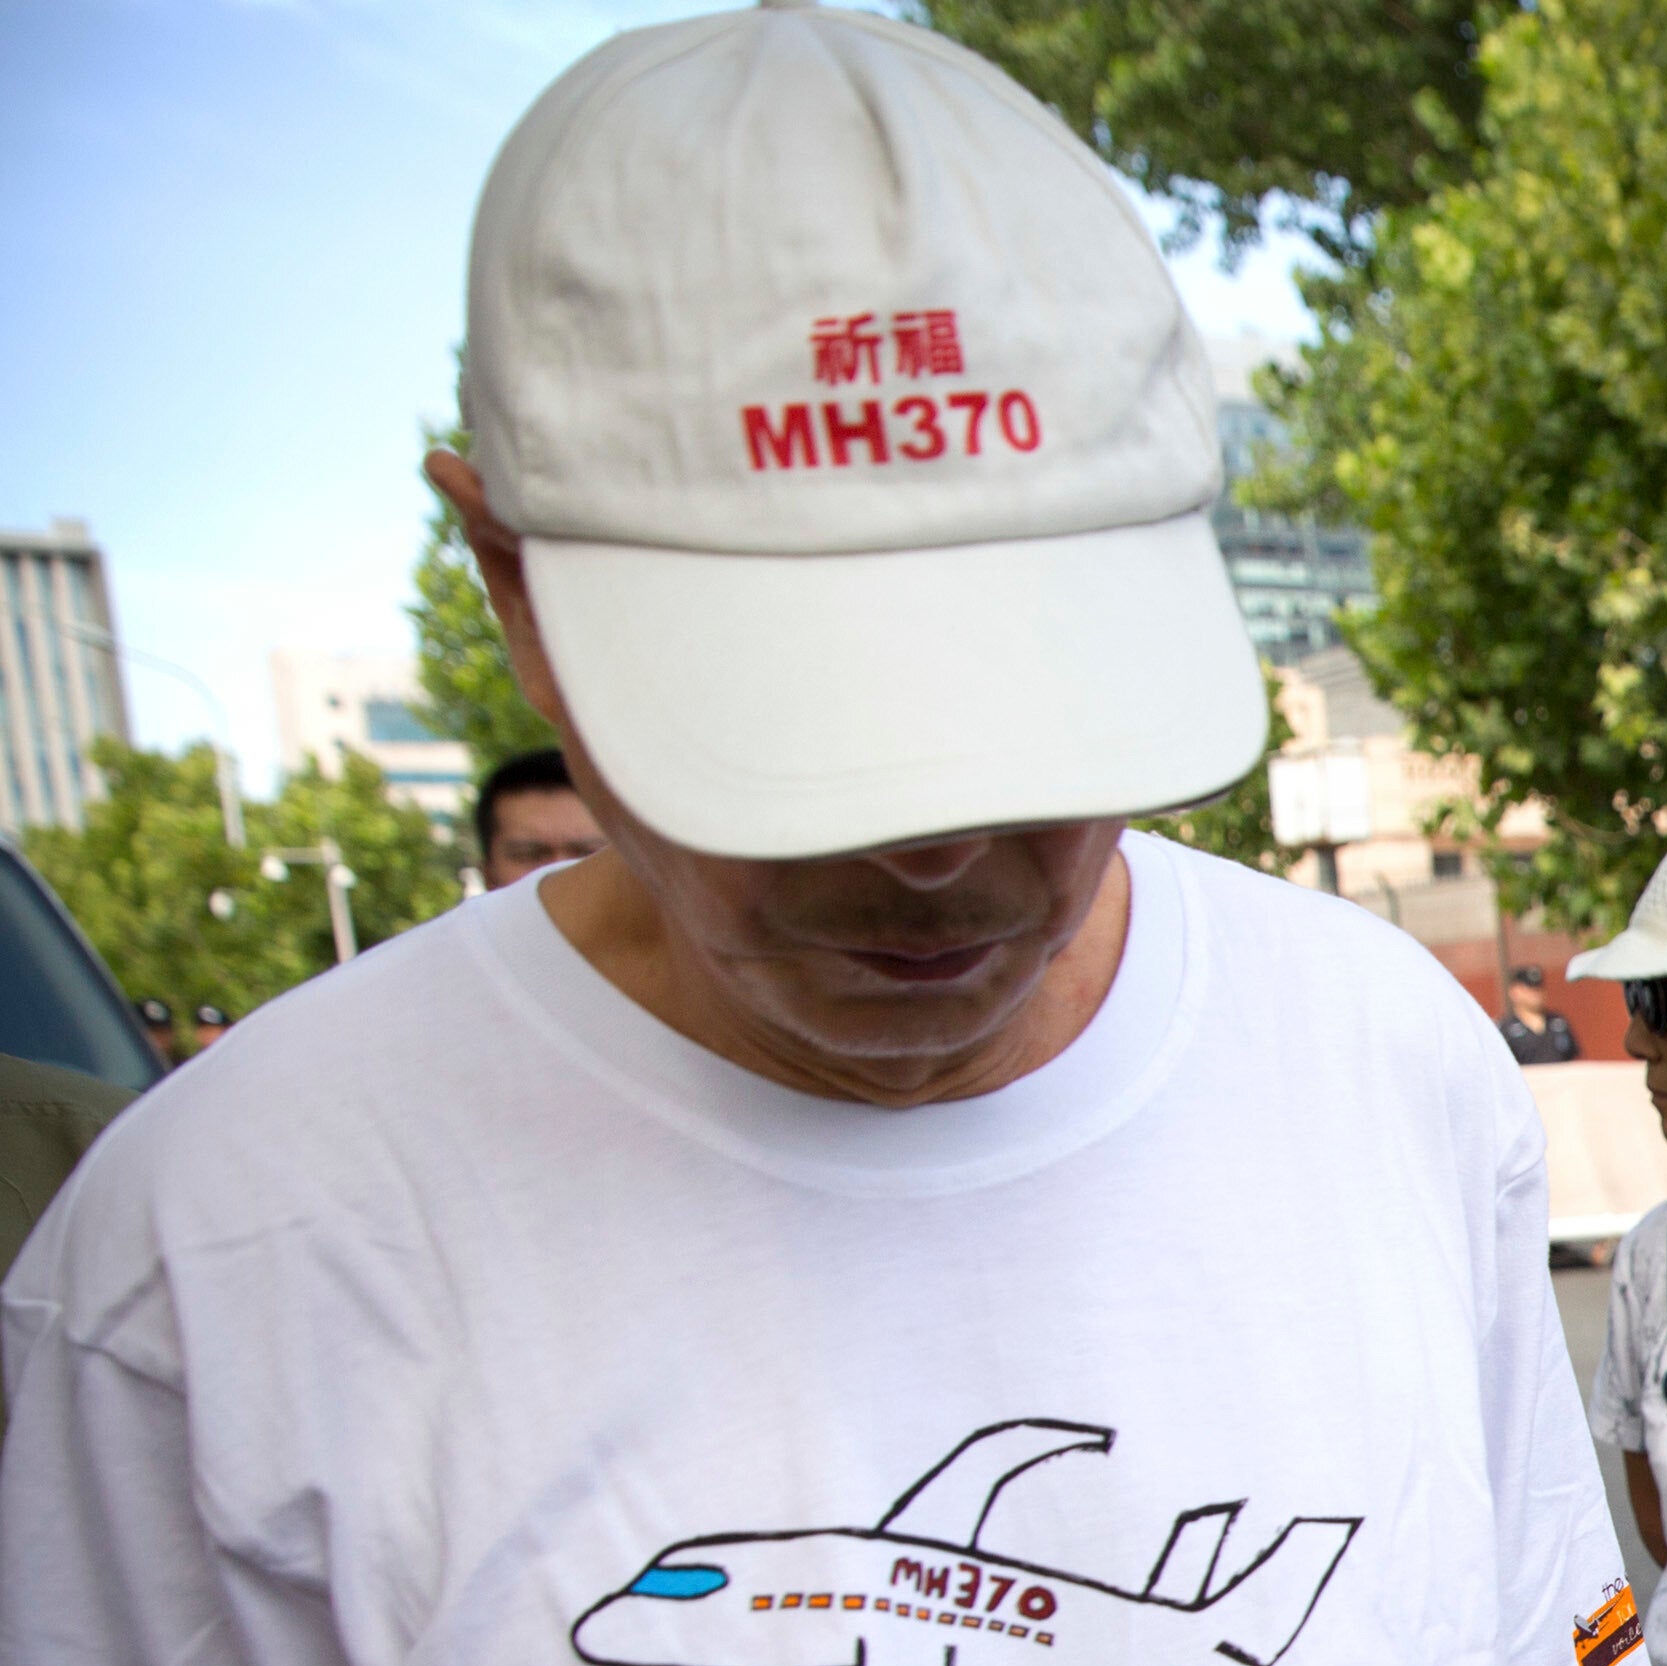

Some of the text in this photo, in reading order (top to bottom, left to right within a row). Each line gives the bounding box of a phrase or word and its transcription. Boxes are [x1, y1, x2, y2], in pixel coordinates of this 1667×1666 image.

[809, 310, 965, 386] 祈福
[741, 389, 1042, 471] MH370
[889, 1557, 1057, 1621] MH370
